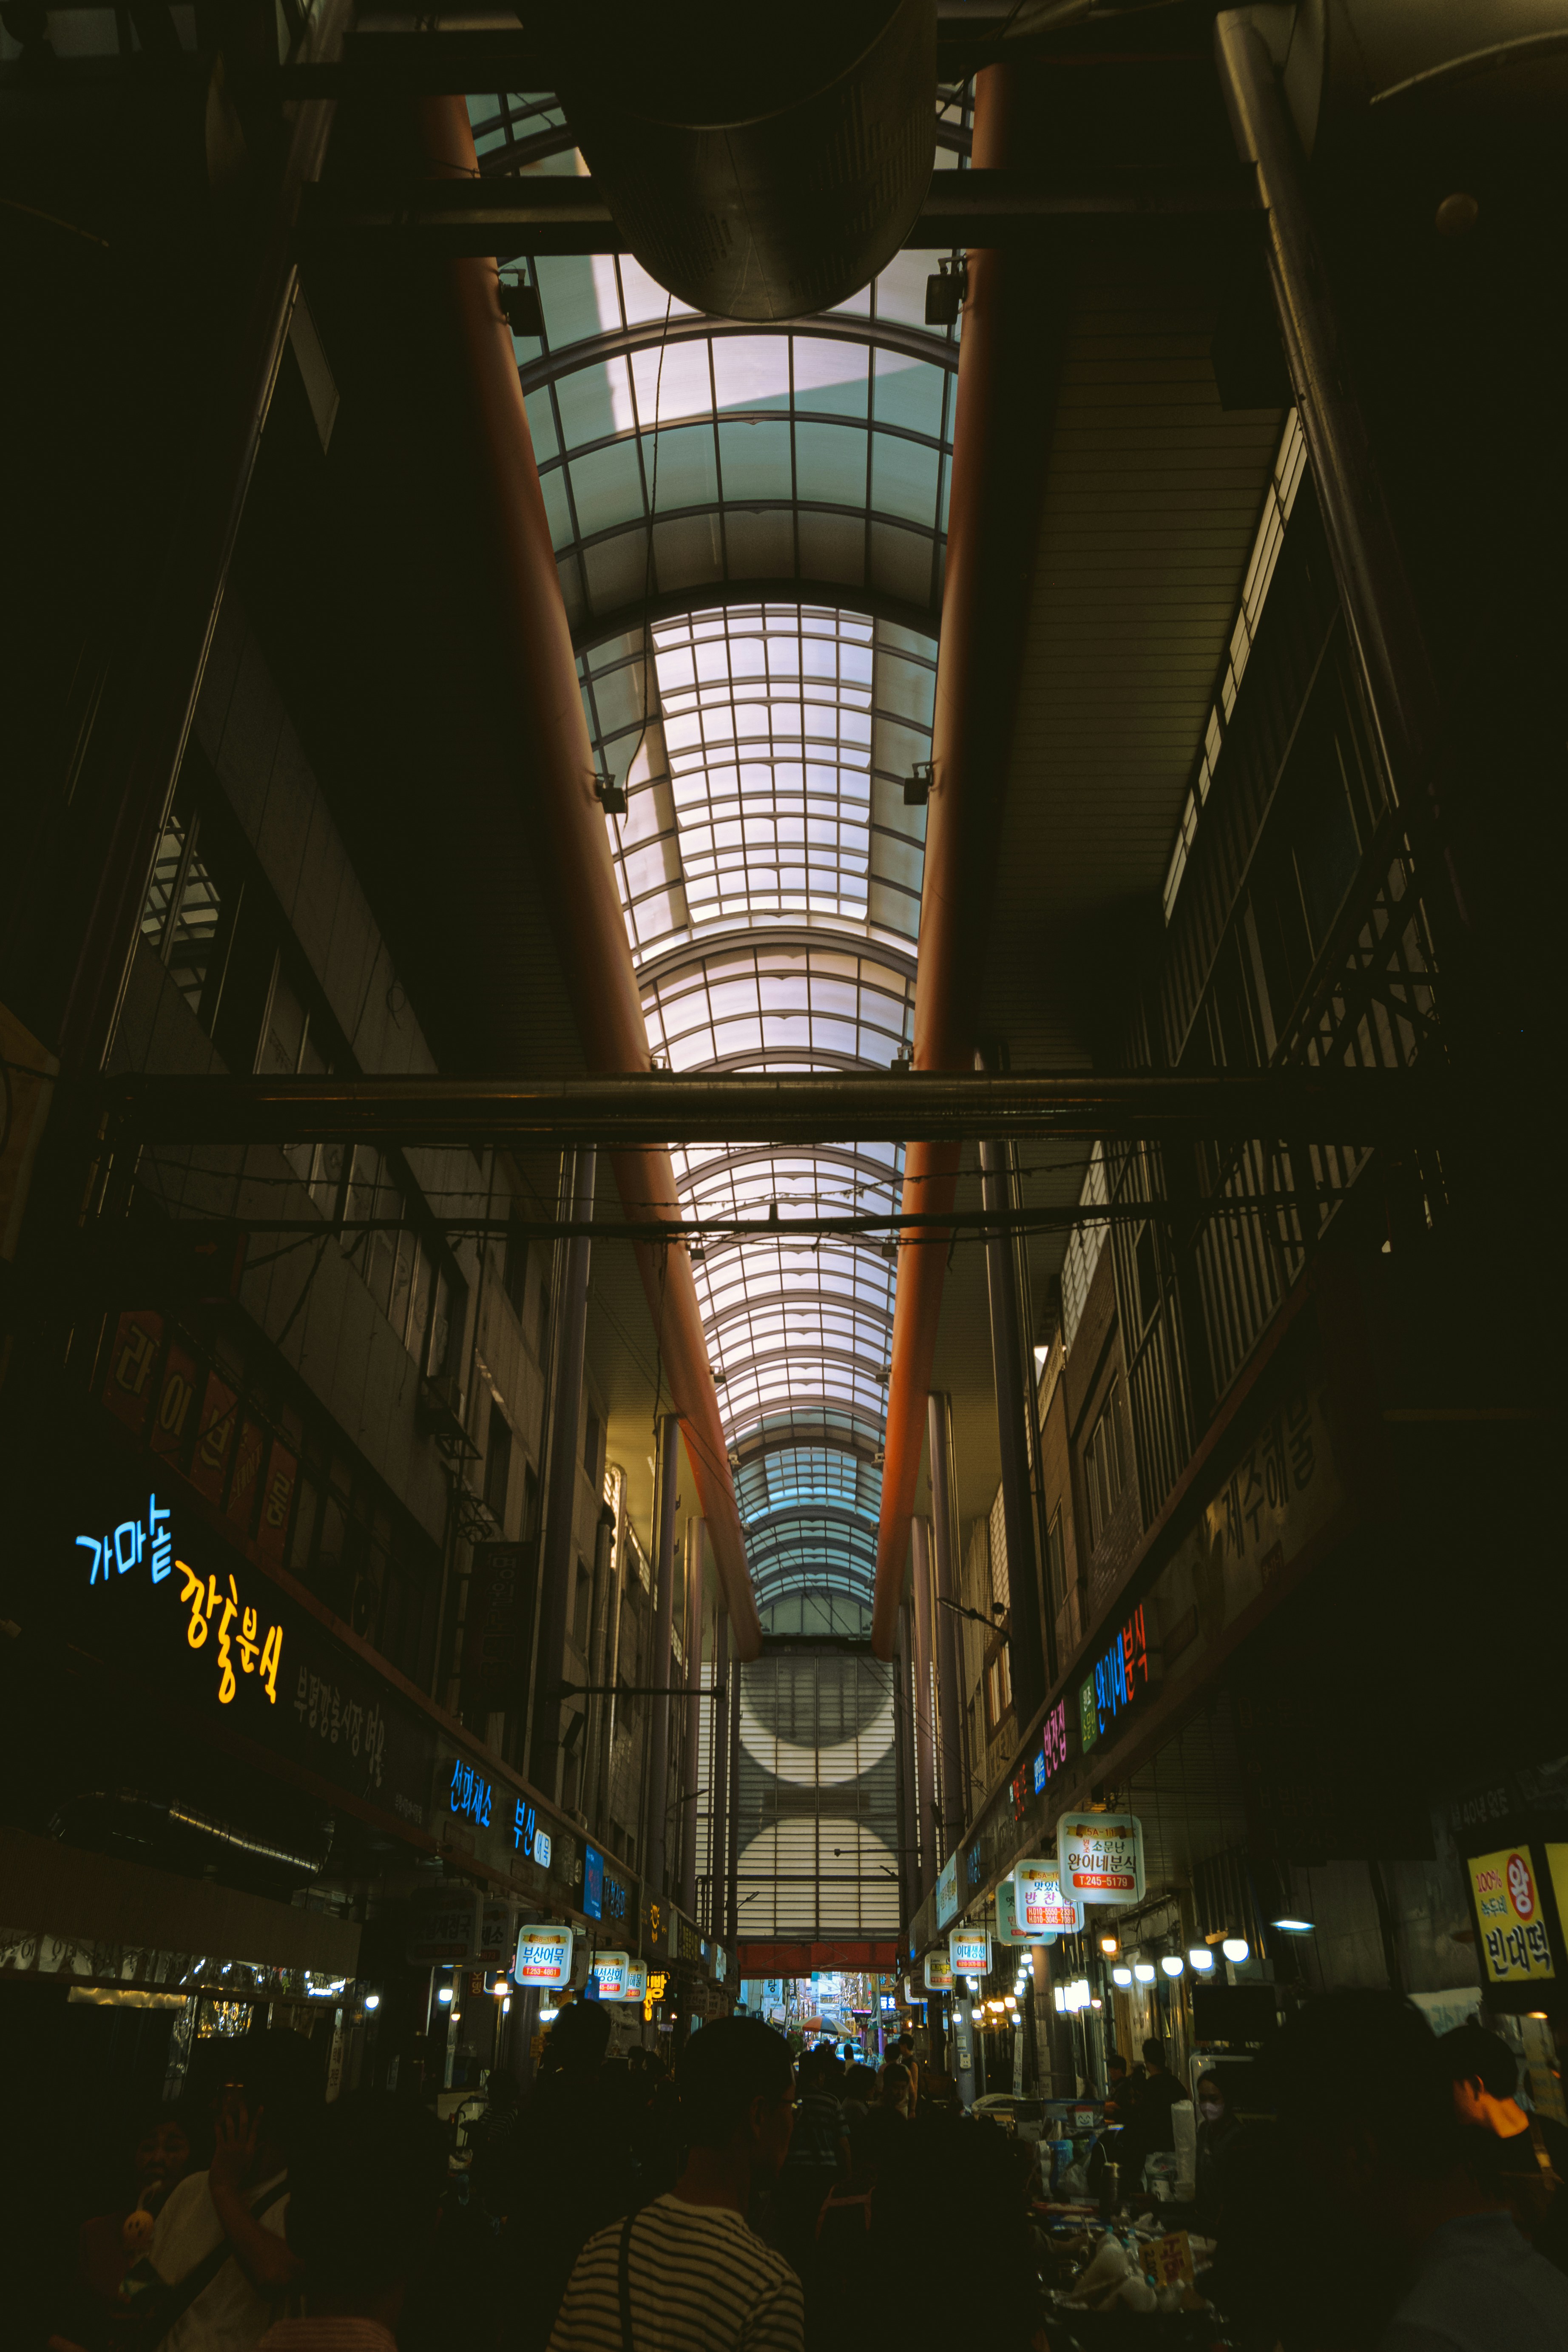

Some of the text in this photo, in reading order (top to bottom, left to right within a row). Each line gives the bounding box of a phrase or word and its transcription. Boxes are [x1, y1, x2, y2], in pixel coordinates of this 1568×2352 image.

[75, 1492, 283, 1704] 가마솥 깡통분식
[1095, 1603, 1148, 1735] 완이네분식
[294, 1665, 364, 1757] 부평깡통시장
[1082, 1705, 1096, 1741] 소문난
[1043, 1699, 1066, 1778] 반찬집
[513, 1798, 549, 1866] 부산 어묵
[1087, 1828, 1114, 1837] 5A-11
[1092, 1840, 1125, 1854] 소문난
[1067, 1853, 1136, 1874] 완이네분식
[1079, 1875, 1128, 1887] T.245-5179
[1476, 1869, 1503, 1893] 100%
[1509, 1858, 1532, 1914] 왕
[523, 1946, 564, 1965] 부산어묵
[957, 1945, 985, 1959] 이대생선
[1486, 1920, 1551, 1976] 빈대떡
[647, 1974, 667, 1999] 빵
